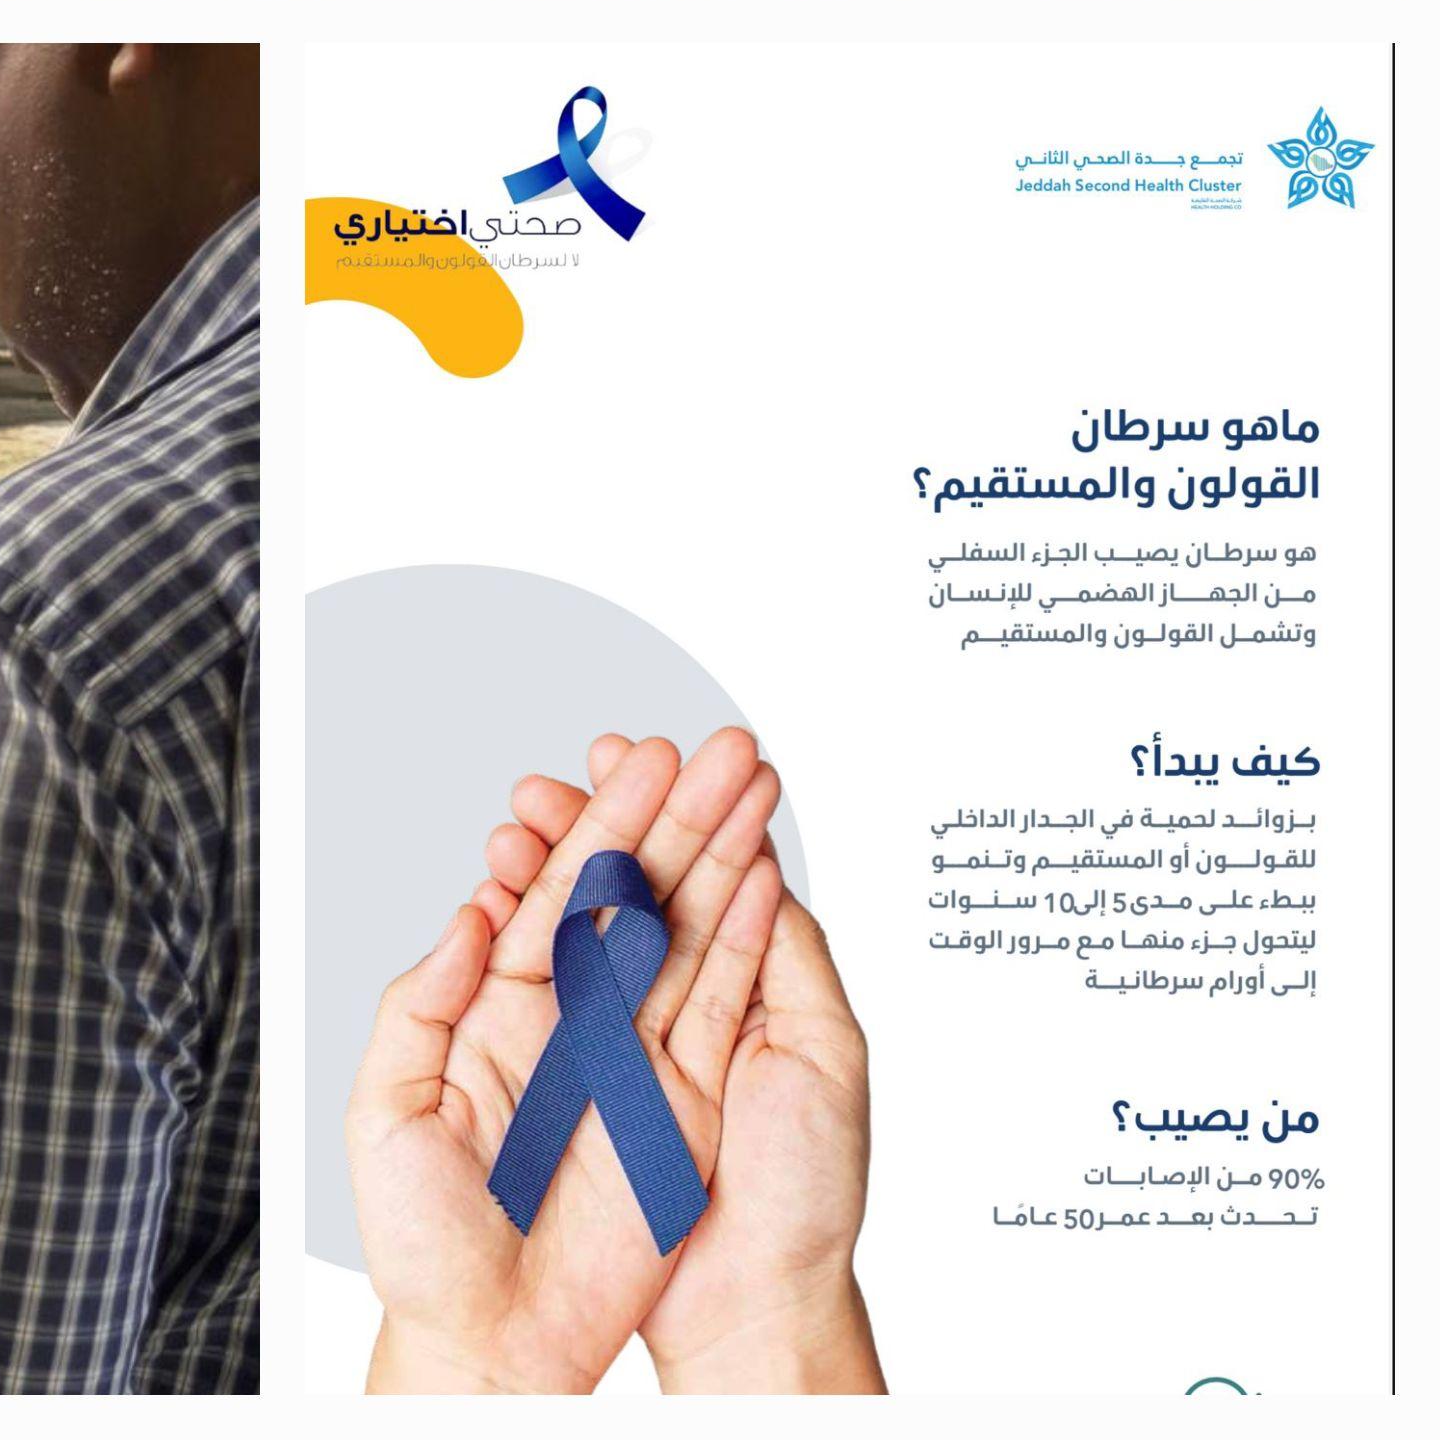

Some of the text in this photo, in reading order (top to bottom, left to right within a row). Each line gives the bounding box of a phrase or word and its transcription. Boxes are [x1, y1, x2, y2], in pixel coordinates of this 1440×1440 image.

[1016, 151, 1243, 171] تجمع جدة الصحي الثاني
[1016, 178, 1241, 191] Jeddah Second Health Cluster
[334, 209, 582, 249] صحتي اختياري
[499, 253, 567, 269] لسرطان
[572, 253, 579, 267] لا
[1072, 409, 1319, 453] ماهو سرطان
[913, 466, 1318, 513] القولون والمستقيم؟
[929, 543, 1316, 573] هو سرطان يصيب الجزء السفلي
[929, 583, 1315, 613] من الجهاز الهضمي للإنسان
[962, 621, 1315, 650] وتشمل القولون والمستقيم
[1131, 732, 1320, 786] كيف يبدأ؟
[931, 808, 1315, 839] بزوائد لحمية في الجدار الداخلي
[932, 842, 1315, 876] للقولون أو المستقيم وتنمو
[929, 890, 1036, 914] سنوات
[1199, 890, 1253, 915] على
[1260, 890, 1315, 913] ببطء
[930, 930, 1315, 960] ليتحول جزء منها مع مرور الوقت
[1086, 963, 1315, 997] إلى أورام سرطانية
[1113, 1100, 1319, 1143] من يصيب؟
[1085, 1166, 1209, 1193] الإصابات
[1217, 1167, 1262, 1191] من
[1157, 1212, 1213, 1230] بعد
[1221, 1206, 1318, 1225] تحدث
